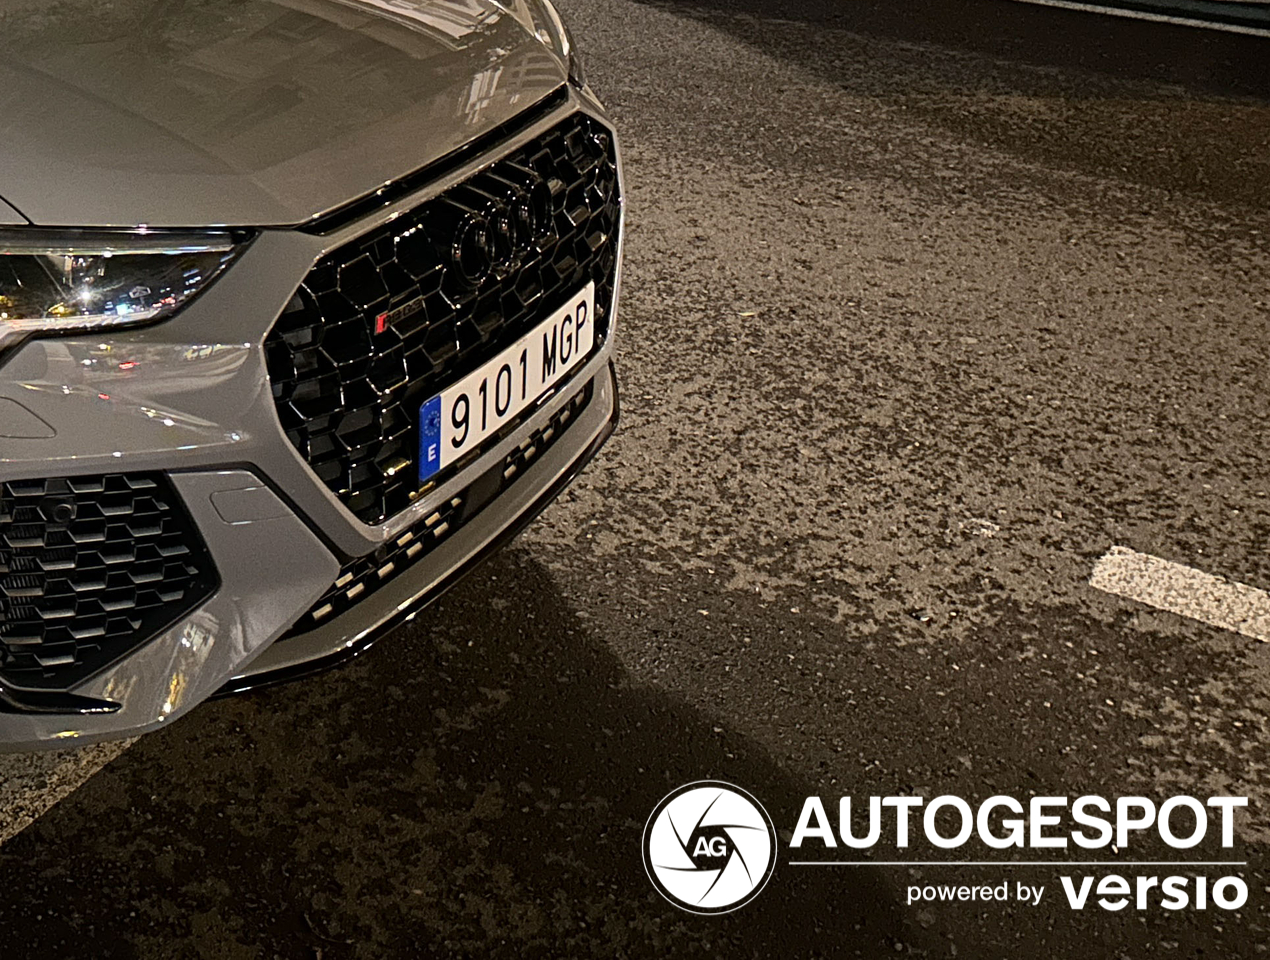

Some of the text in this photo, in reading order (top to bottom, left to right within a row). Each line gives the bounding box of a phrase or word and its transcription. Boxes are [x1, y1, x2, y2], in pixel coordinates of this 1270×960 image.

[450, 299, 588, 449] 9101 MGP
[427, 442, 437, 462] E
